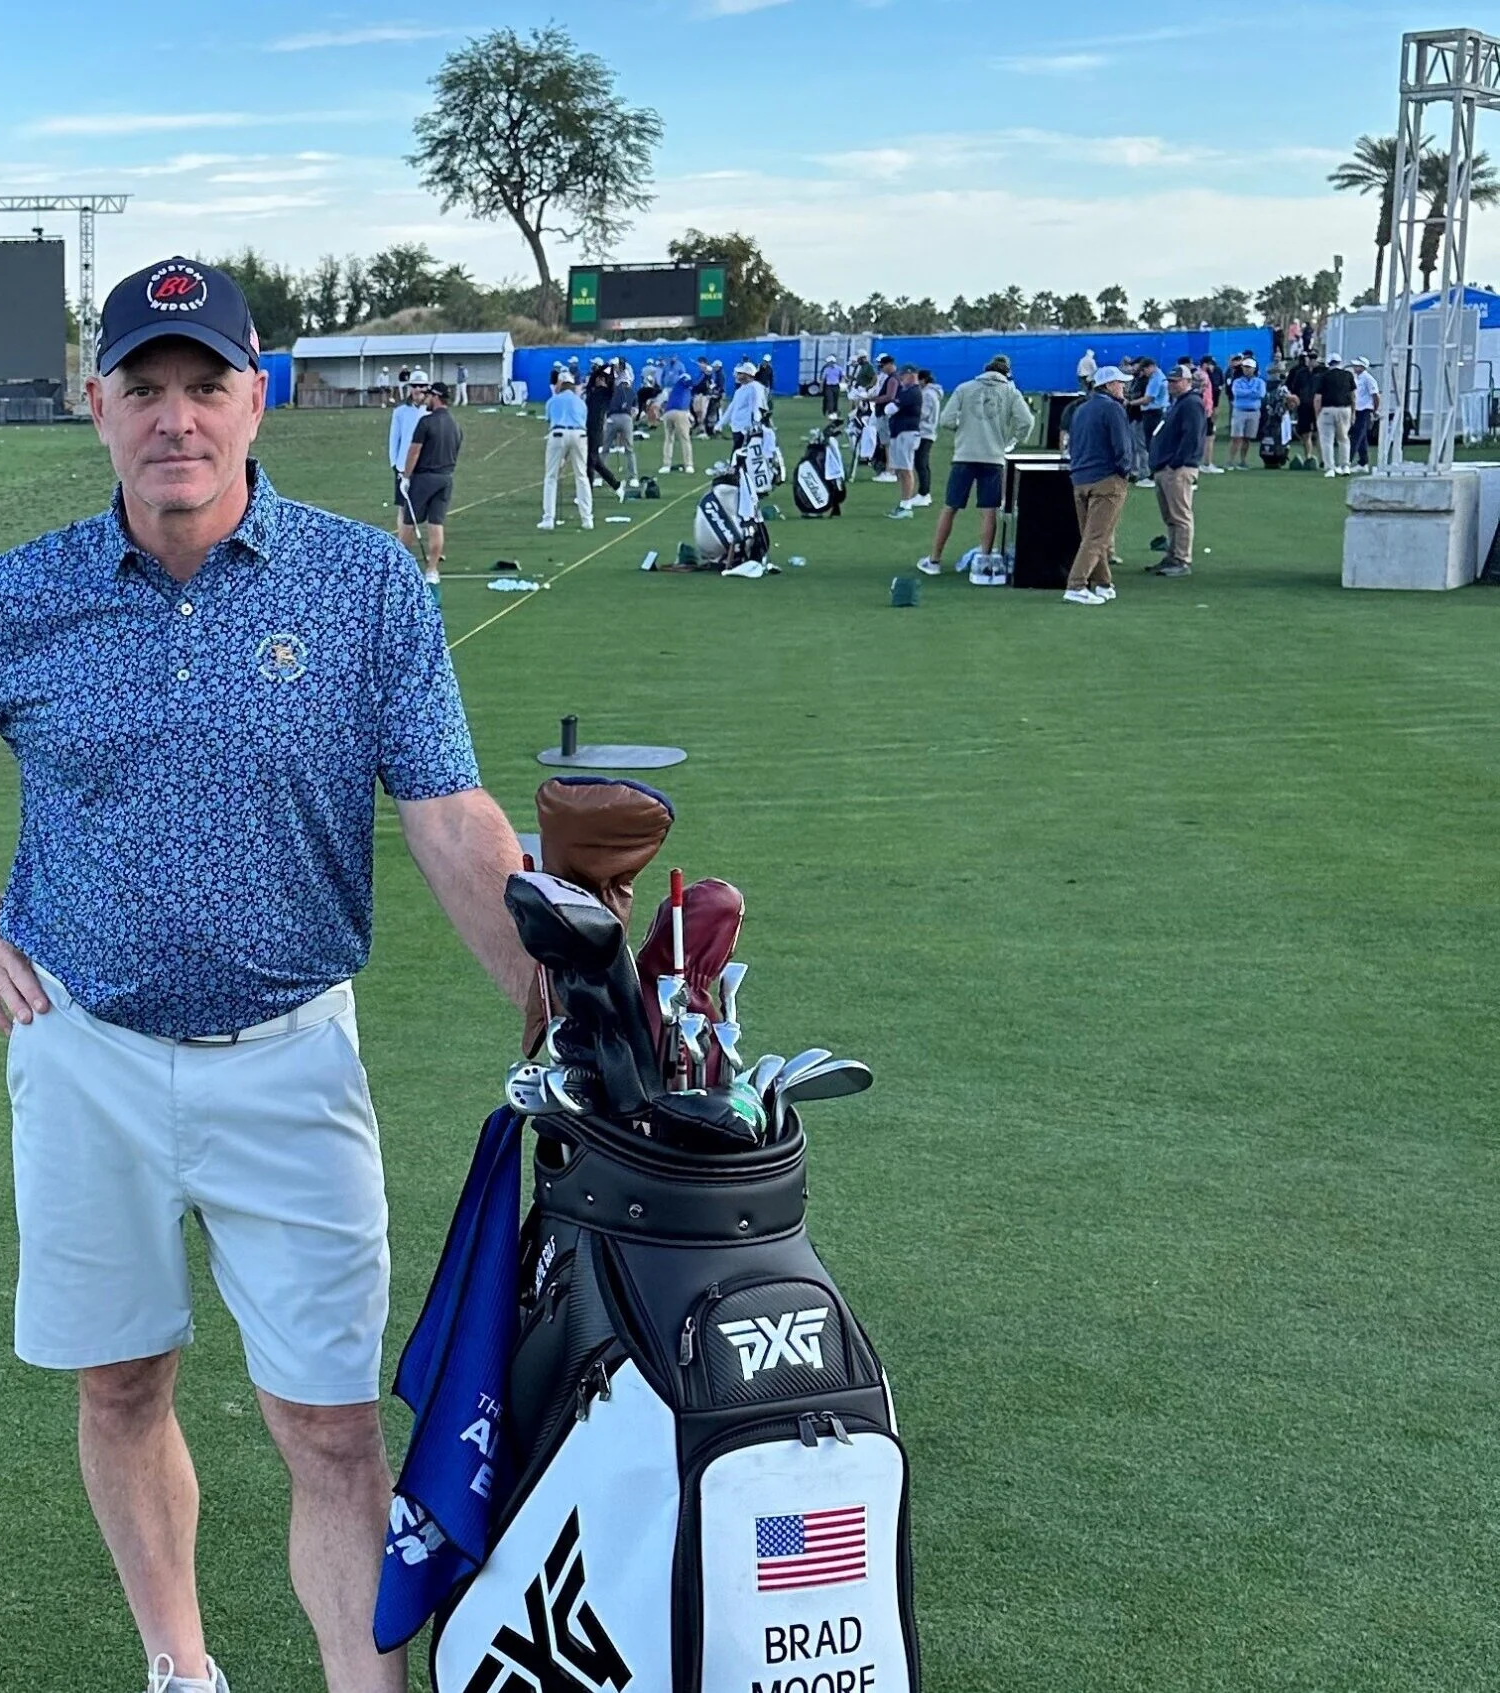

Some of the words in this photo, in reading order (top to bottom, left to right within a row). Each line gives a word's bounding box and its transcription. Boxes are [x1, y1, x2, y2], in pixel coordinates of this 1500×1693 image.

[151, 264, 203, 281] CUSTOM
[150, 299, 204, 311] WEDGES
[749, 444, 768, 491] PING
[717, 1306, 829, 1381] PXG
[765, 1616, 862, 1664] BRAD
